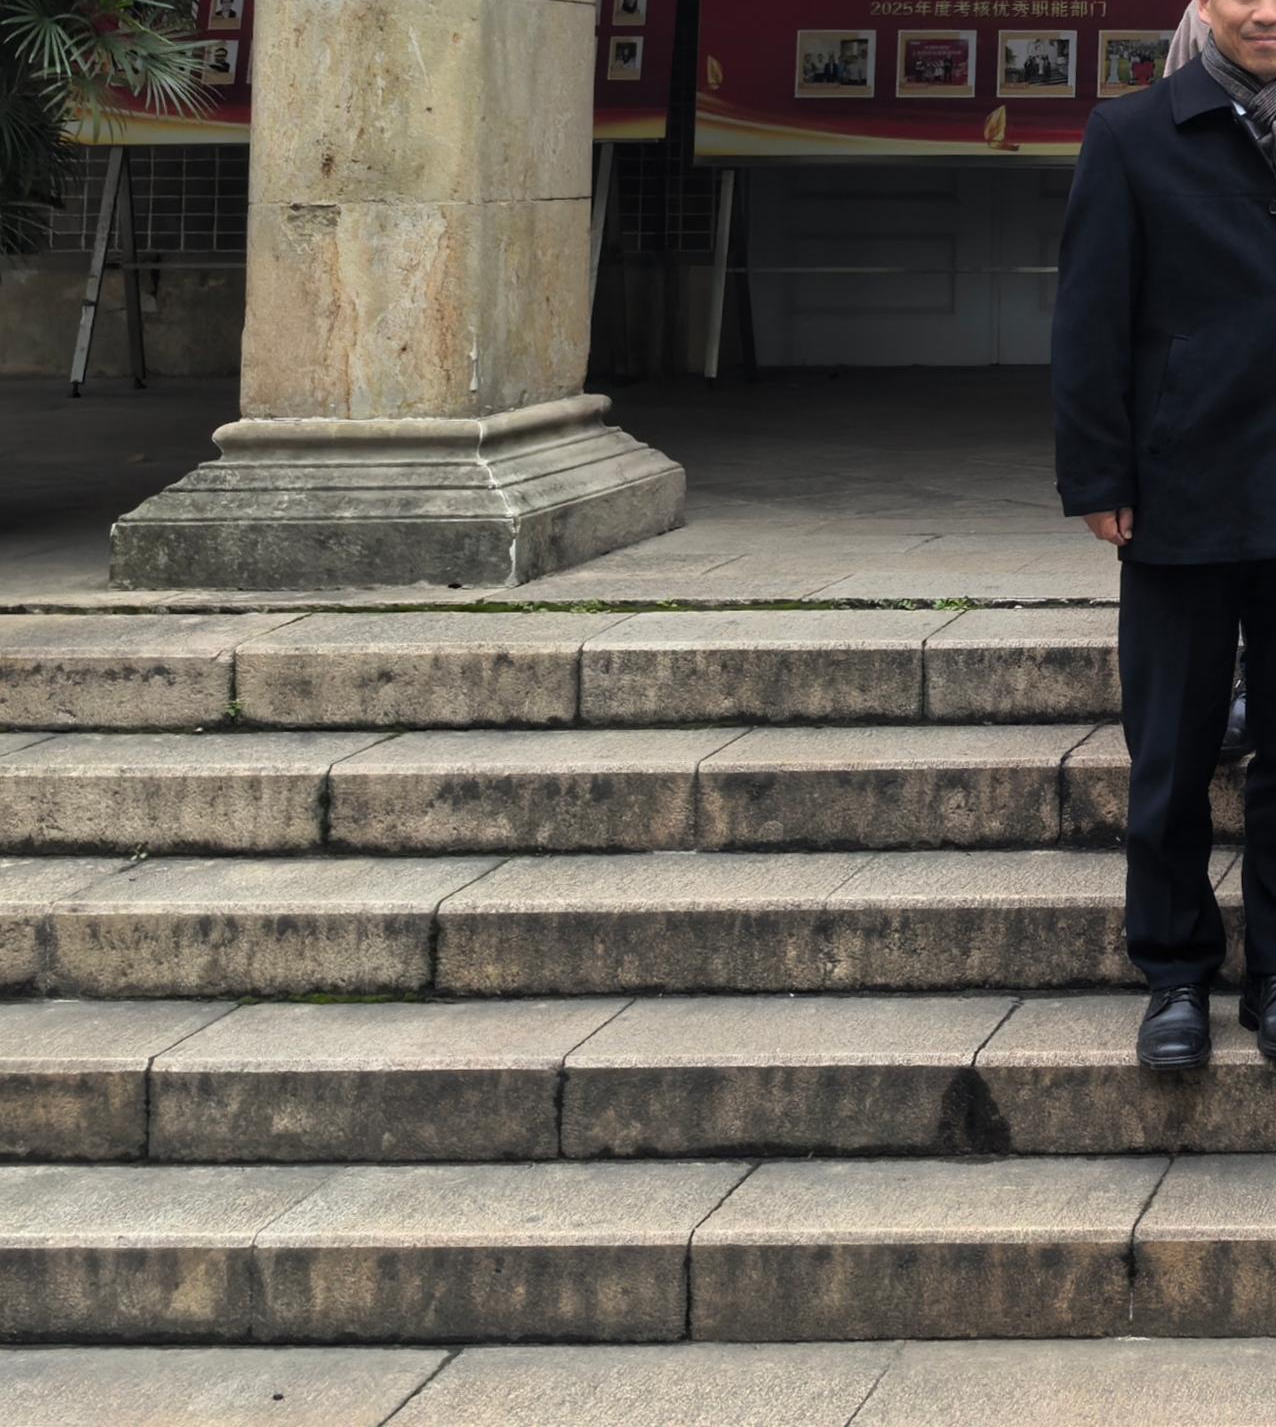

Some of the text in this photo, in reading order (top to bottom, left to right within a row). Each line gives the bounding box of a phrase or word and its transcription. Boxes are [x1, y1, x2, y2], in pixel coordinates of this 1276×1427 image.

[870, 0, 1107, 19] 2025年度考核优秀职能部门
